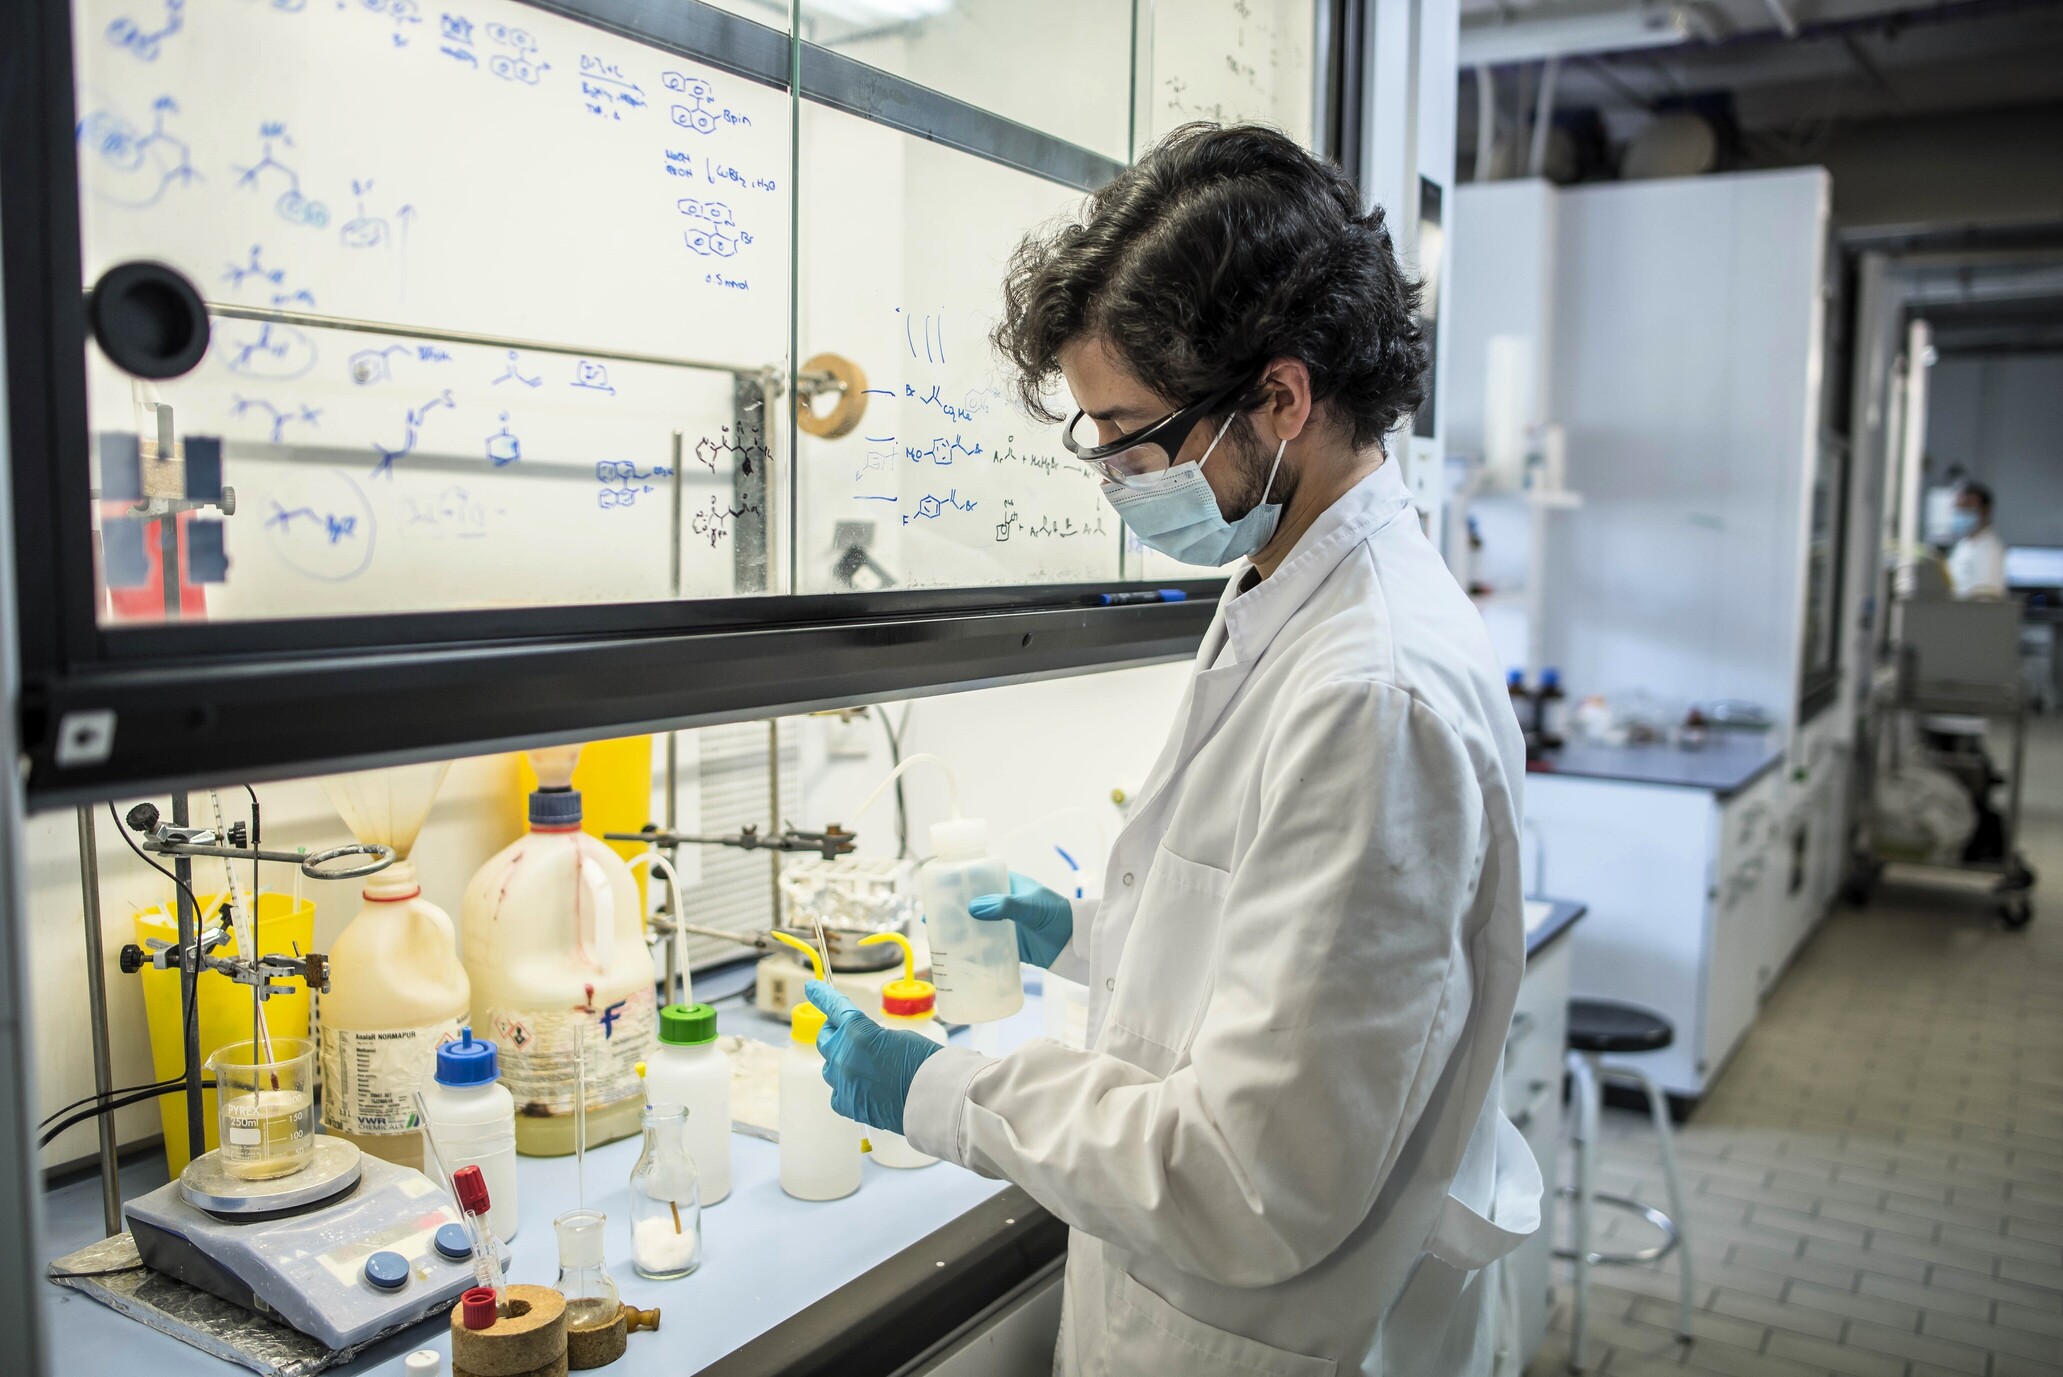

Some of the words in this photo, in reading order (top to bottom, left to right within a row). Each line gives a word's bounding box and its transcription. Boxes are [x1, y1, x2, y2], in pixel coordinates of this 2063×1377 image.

[723, 109, 752, 127] Bpin
[377, 1031, 416, 1041] NORMAPUR
[228, 1104, 260, 1117] PYREX
[230, 1117, 259, 1128] 250ml
[289, 1112, 303, 1123] 150
[357, 1116, 387, 1125] VWR
[289, 1129, 304, 1141] 100
